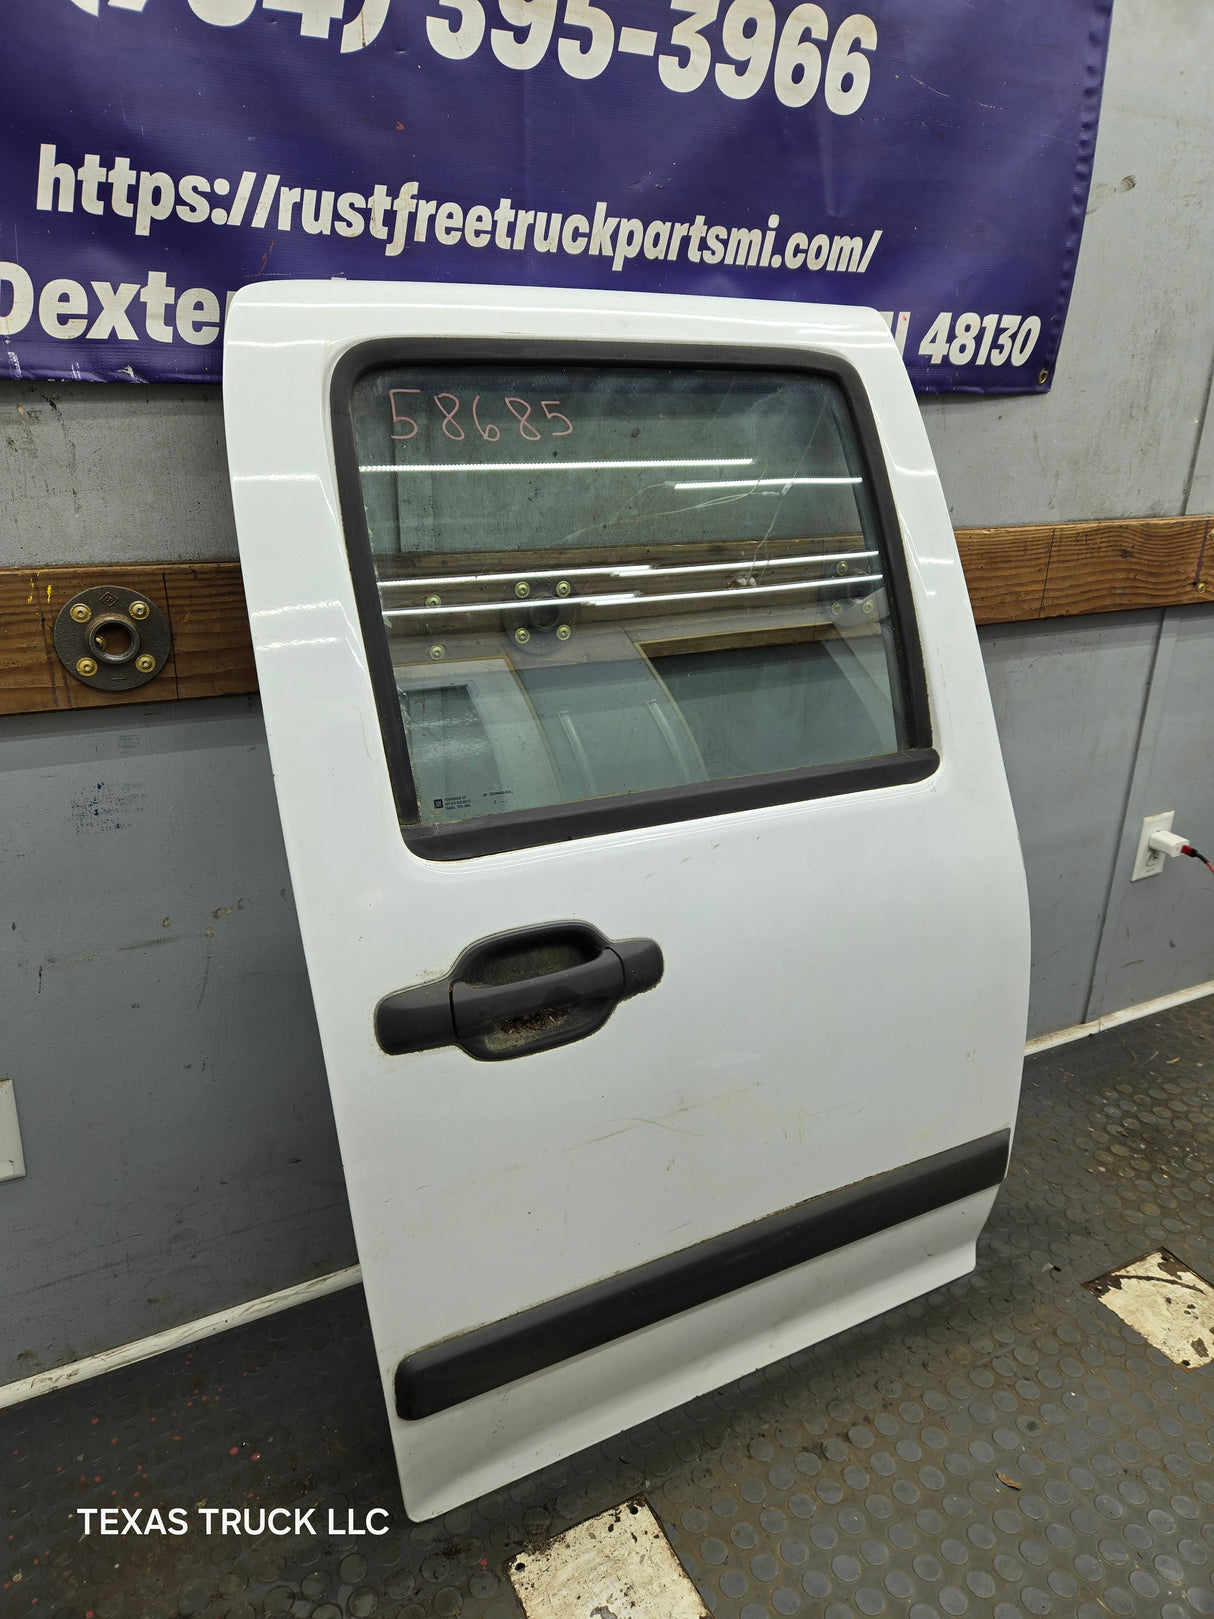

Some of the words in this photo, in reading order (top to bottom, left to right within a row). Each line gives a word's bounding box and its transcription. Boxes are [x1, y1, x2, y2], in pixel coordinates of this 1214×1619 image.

[36, 143, 883, 273] https://rustfreetruckpartsmi.com/
[0, 261, 237, 346] Dexte
[918, 312, 1041, 367] 48130
[389, 389, 573, 441] 58685
